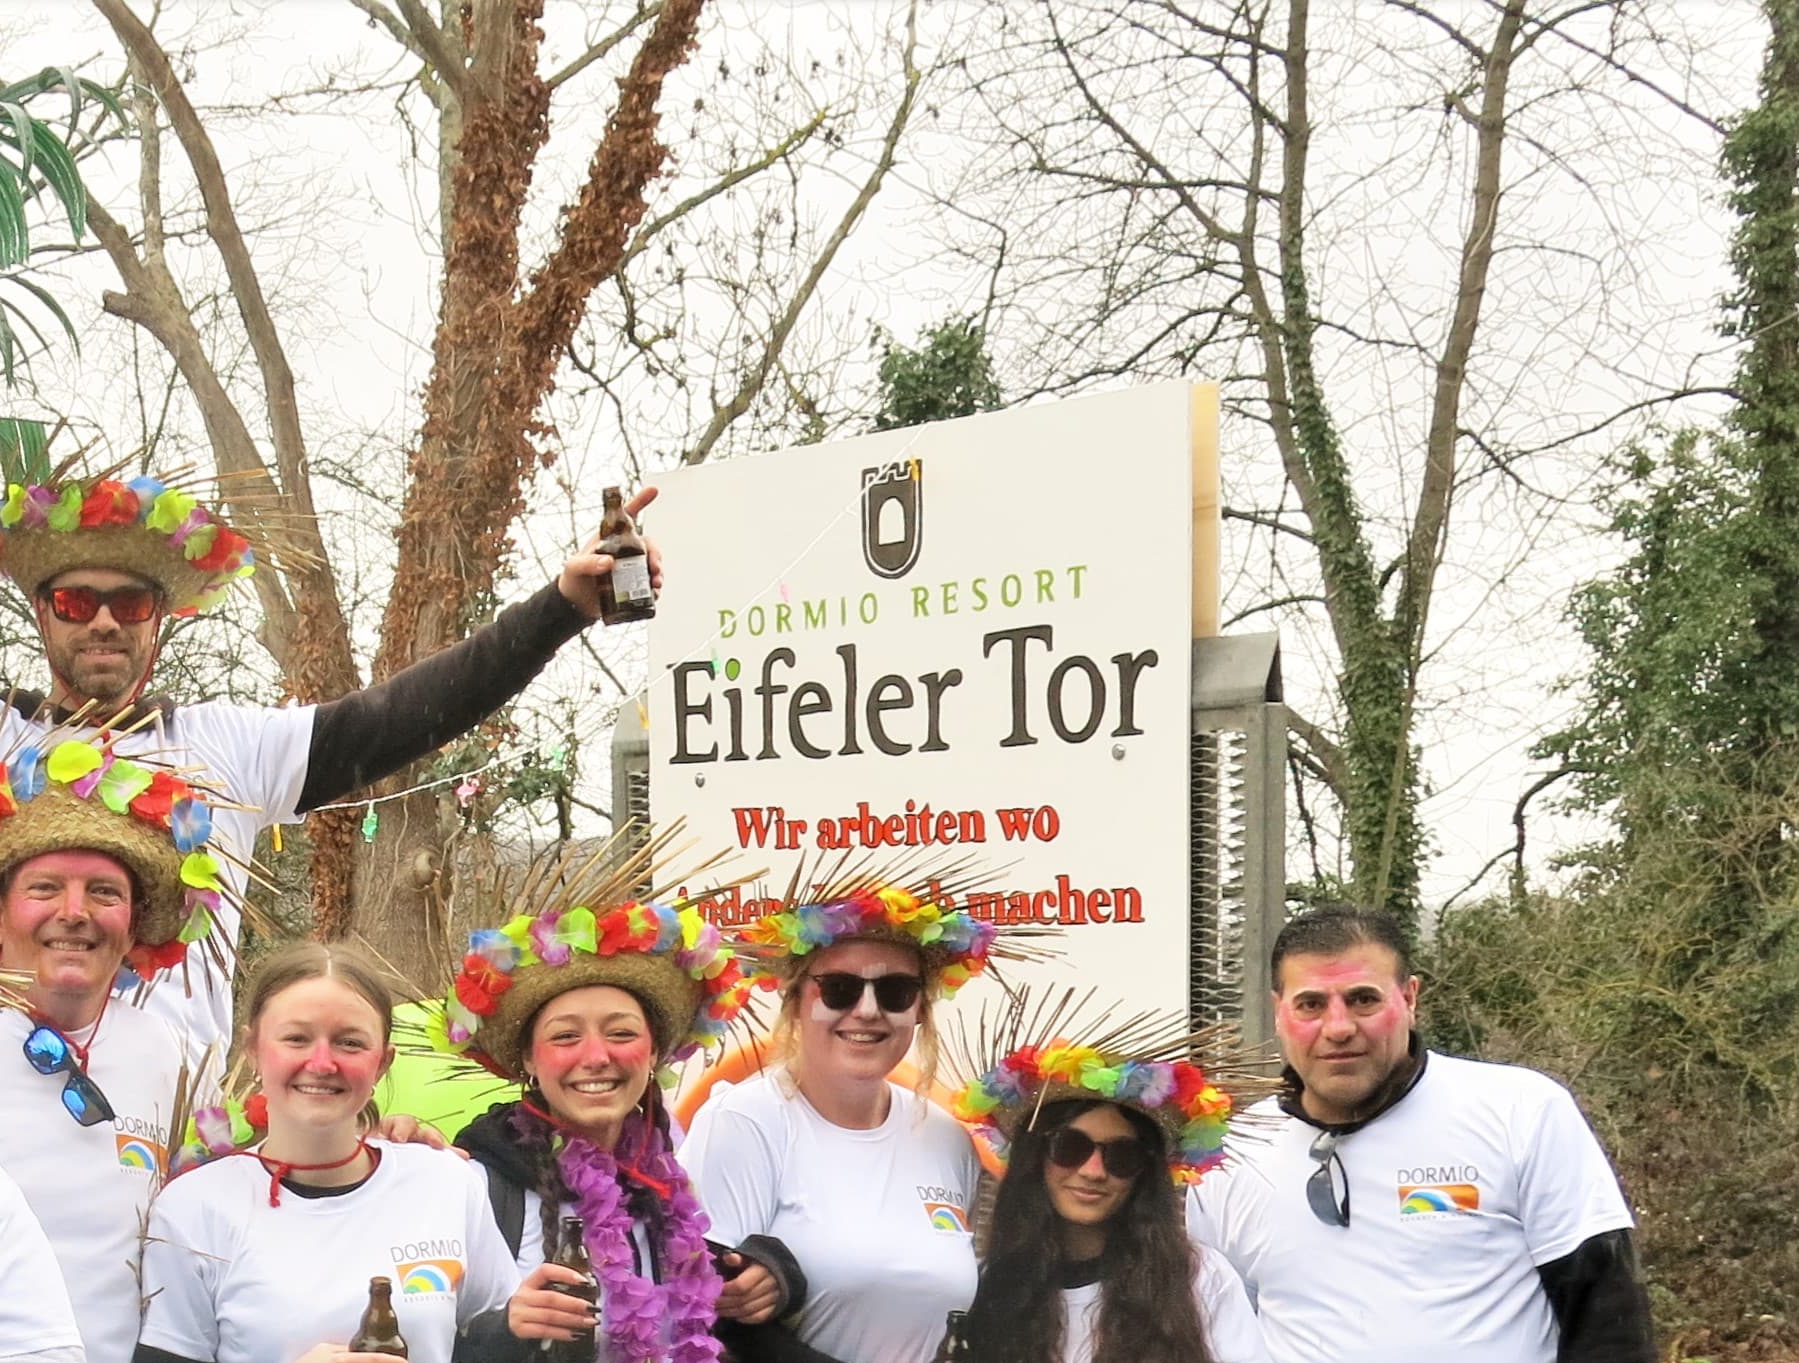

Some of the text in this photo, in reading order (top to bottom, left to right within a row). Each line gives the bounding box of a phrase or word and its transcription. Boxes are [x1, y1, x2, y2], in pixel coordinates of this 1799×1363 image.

[717, 564, 1088, 639] DORMIO RESORT
[668, 624, 1159, 765] Eifeler Tor
[731, 798, 1061, 850] Wir arbeiten wo
[966, 873, 1145, 926] machen
[1397, 1165, 1479, 1185] DORMIO
[390, 1239, 462, 1263] DORMIO
